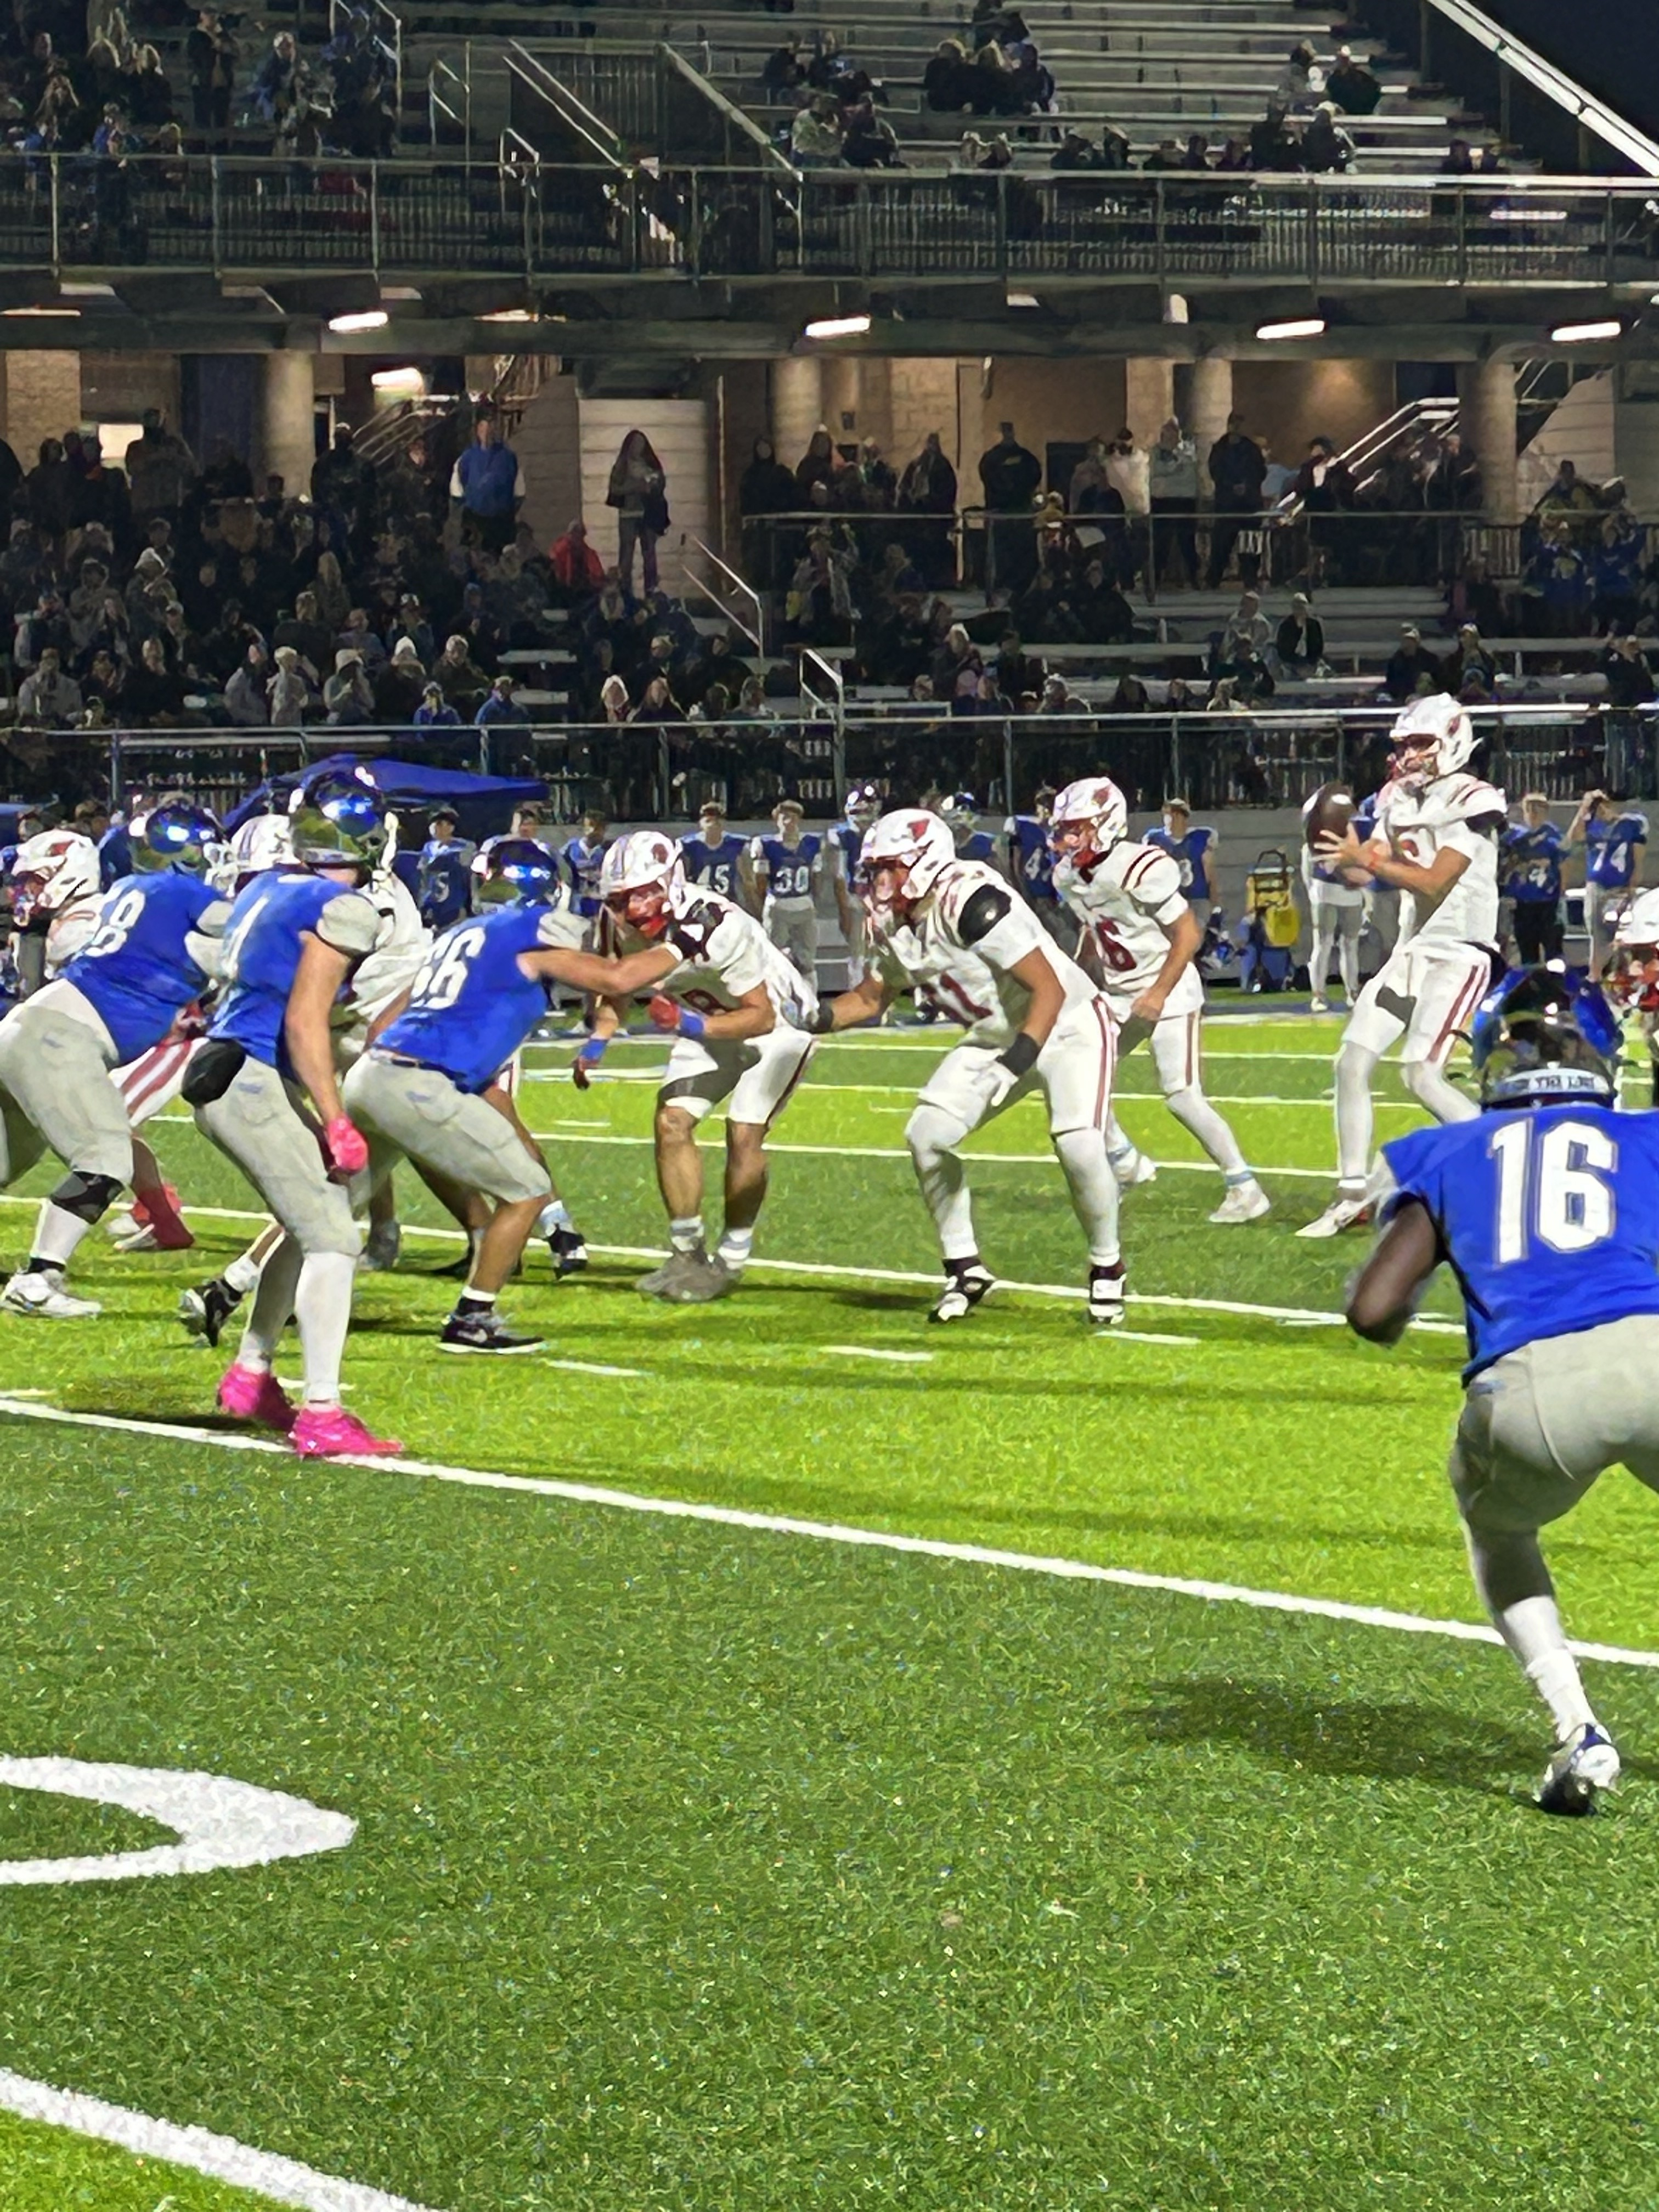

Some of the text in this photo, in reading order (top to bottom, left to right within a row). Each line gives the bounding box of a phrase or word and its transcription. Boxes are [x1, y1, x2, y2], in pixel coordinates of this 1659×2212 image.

[1593, 842, 1628, 873] 74
[696, 864, 731, 894] 45
[773, 865, 809, 893] 30
[1487, 1116, 1618, 1268] 16
